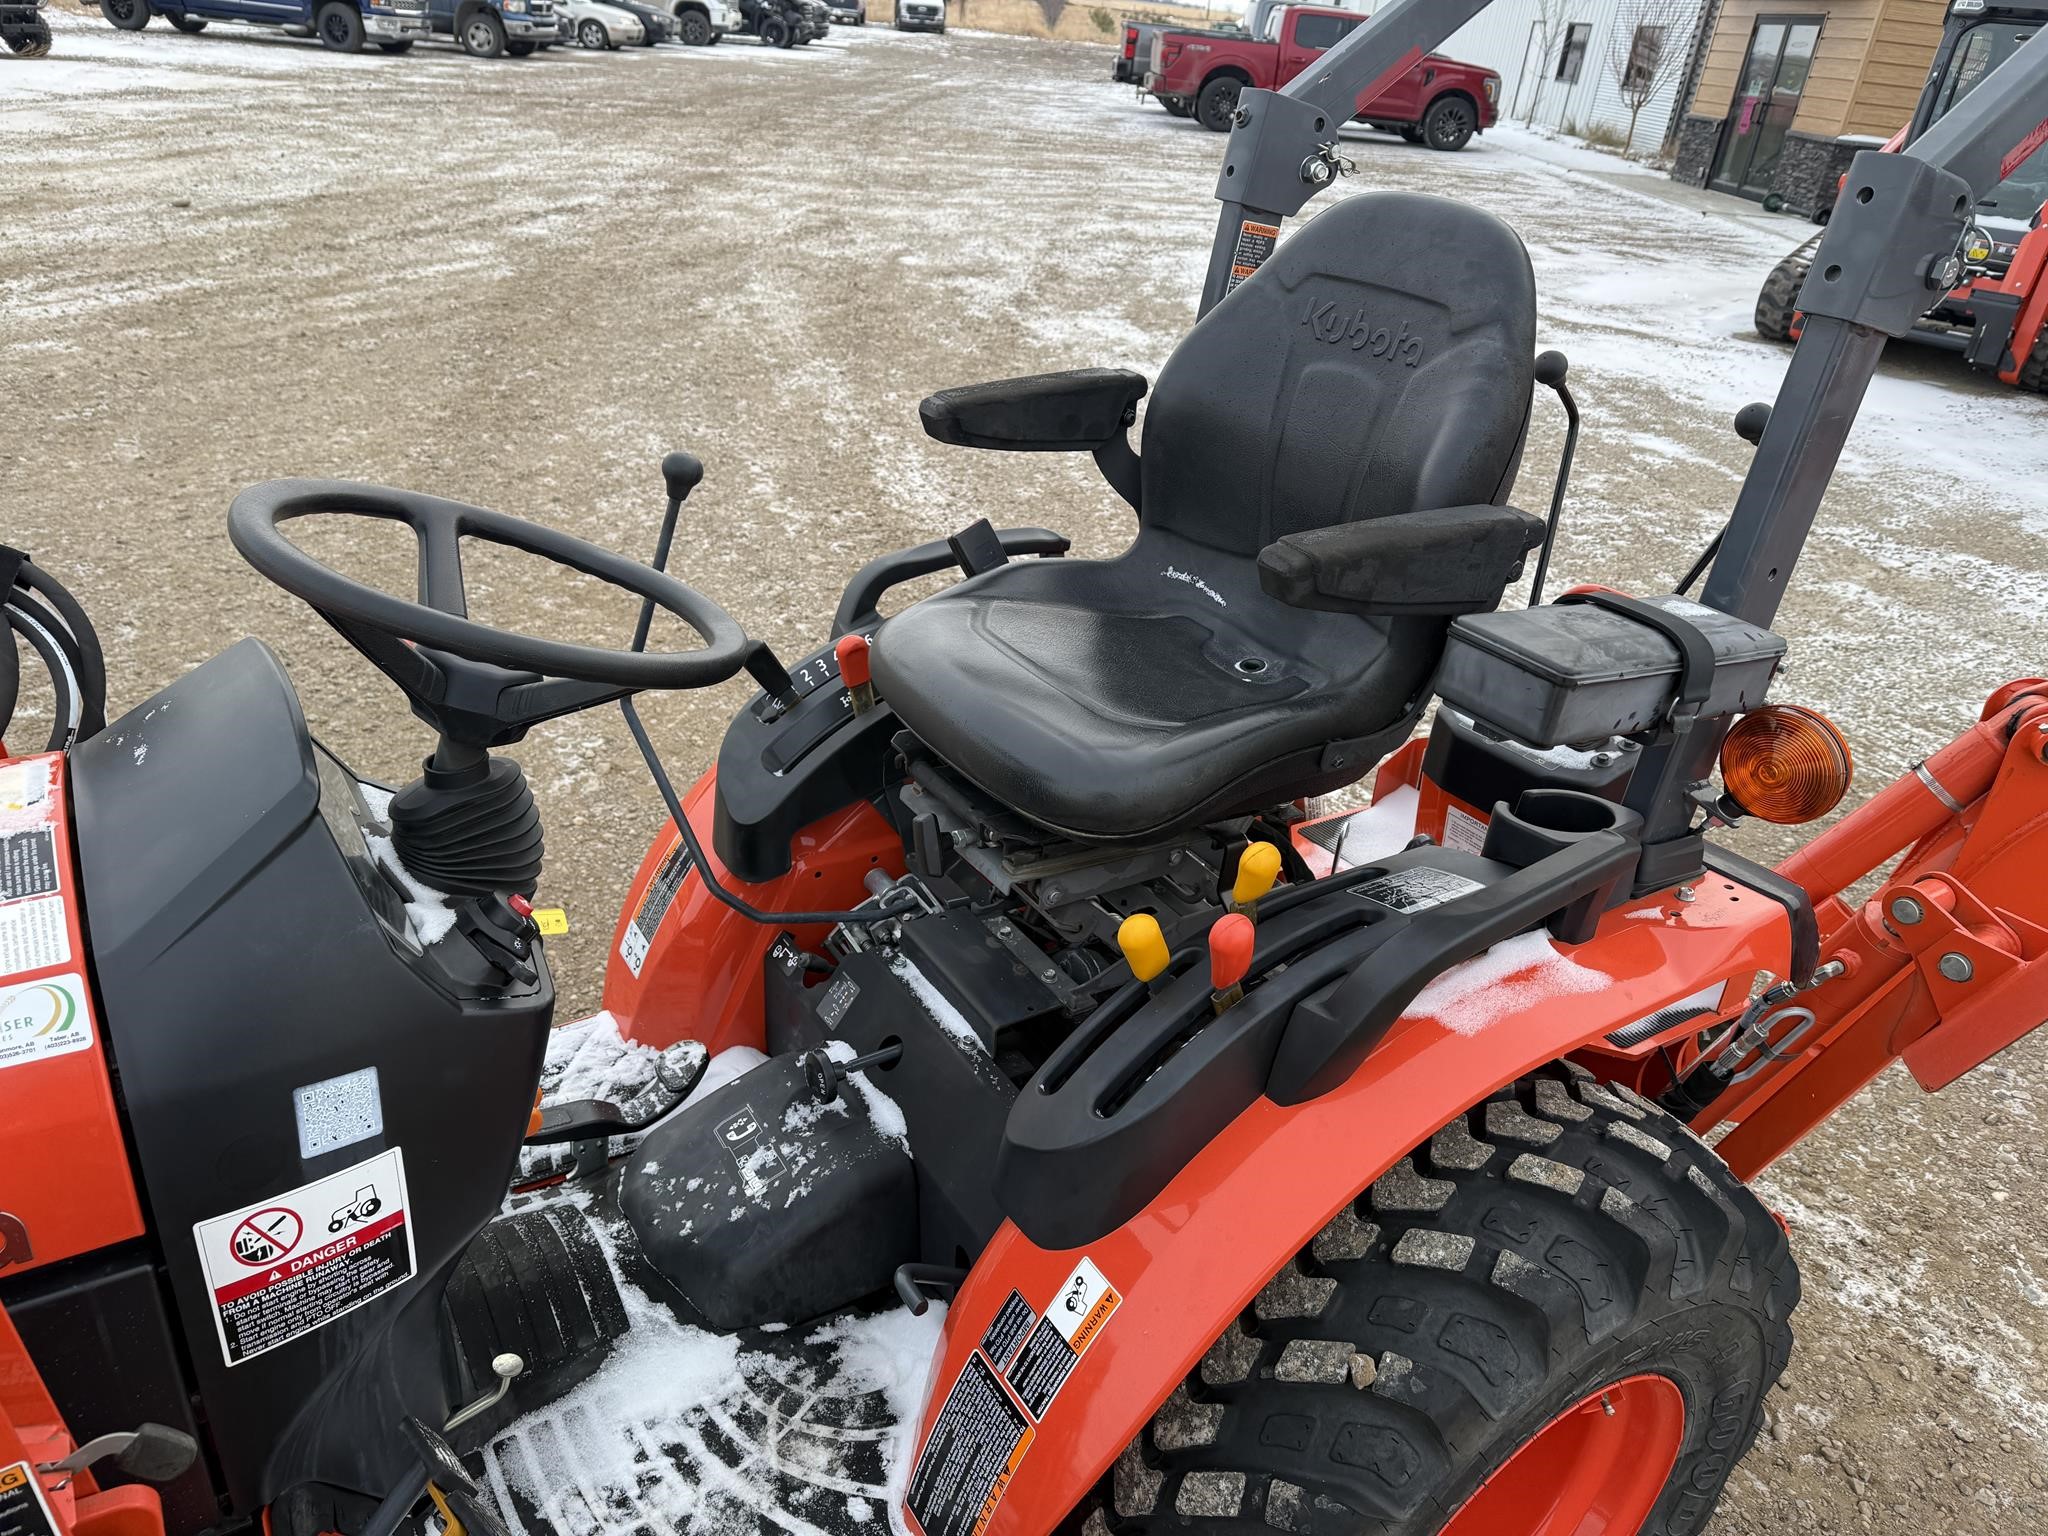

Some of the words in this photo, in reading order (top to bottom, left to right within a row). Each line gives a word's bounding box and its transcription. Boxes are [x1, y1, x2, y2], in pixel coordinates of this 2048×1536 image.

[1302, 296, 1424, 367] Kubota
[800, 669, 812, 682] 2
[816, 659, 826, 672] 3
[0, 1017, 34, 1034] SER
[818, 1072, 826, 1095] OPEN
[220, 1301, 234, 1311] TO
[236, 1288, 266, 1305] AVOID
[268, 1268, 313, 1291] POSSIBLE
[315, 1253, 346, 1271] INJURY
[348, 1246, 361, 1256] OR
[363, 1231, 391, 1249] DEATH
[290, 1236, 356, 1271] DANGER
[222, 1302, 250, 1317] FROM
[261, 1279, 303, 1301] MACHINE
[305, 1257, 352, 1282] RUNAWAY.
[234, 1311, 245, 1319] Do
[247, 1305, 260, 1314] not
[261, 1297, 278, 1308] start
[280, 1285, 306, 1301] engine
[307, 1280, 316, 1290] by
[318, 1266, 347, 1285] shorting
[348, 1256, 371, 1269] across
[235, 1312, 260, 1326] starter
[262, 1296, 297, 1315] terminals
[308, 1274, 344, 1296] bypassing
[346, 1268, 357, 1277] the
[359, 1258, 379, 1271] safety
[237, 1321, 254, 1332] start
[256, 1309, 282, 1324] switch.
[284, 1294, 315, 1312] Machine
[317, 1287, 332, 1298] may
[334, 1278, 350, 1289] start
[359, 1266, 375, 1278] gear
[376, 1258, 389, 1268] and
[238, 1326, 259, 1338] move
[268, 1310, 294, 1325] normal
[295, 1297, 322, 1314] starting
[324, 1283, 351, 1301] circuitry
[360, 1262, 394, 1284] bypassed.
[239, 1332, 258, 1344] Start
[259, 1321, 285, 1337] engine
[287, 1312, 303, 1325] only
[304, 1304, 321, 1316] from
[322, 1286, 357, 1308] operator's
[358, 1279, 373, 1289] seat
[375, 1271, 388, 1281] with
[242, 1343, 265, 1356] Never
[267, 1334, 284, 1345] start
[285, 1322, 310, 1338] engine
[311, 1312, 330, 1325] while
[332, 1296, 361, 1316] standing
[373, 1285, 383, 1294] the
[385, 1271, 409, 1288] ground.
[241, 1326, 288, 1350] transmission
[290, 1318, 304, 1329] and
[306, 1309, 323, 1321] PTO
[324, 1300, 342, 1312] OFF.
[1001, 1320, 1030, 1365] IMPORTANT
[1073, 1302, 1107, 1349] WARNING
